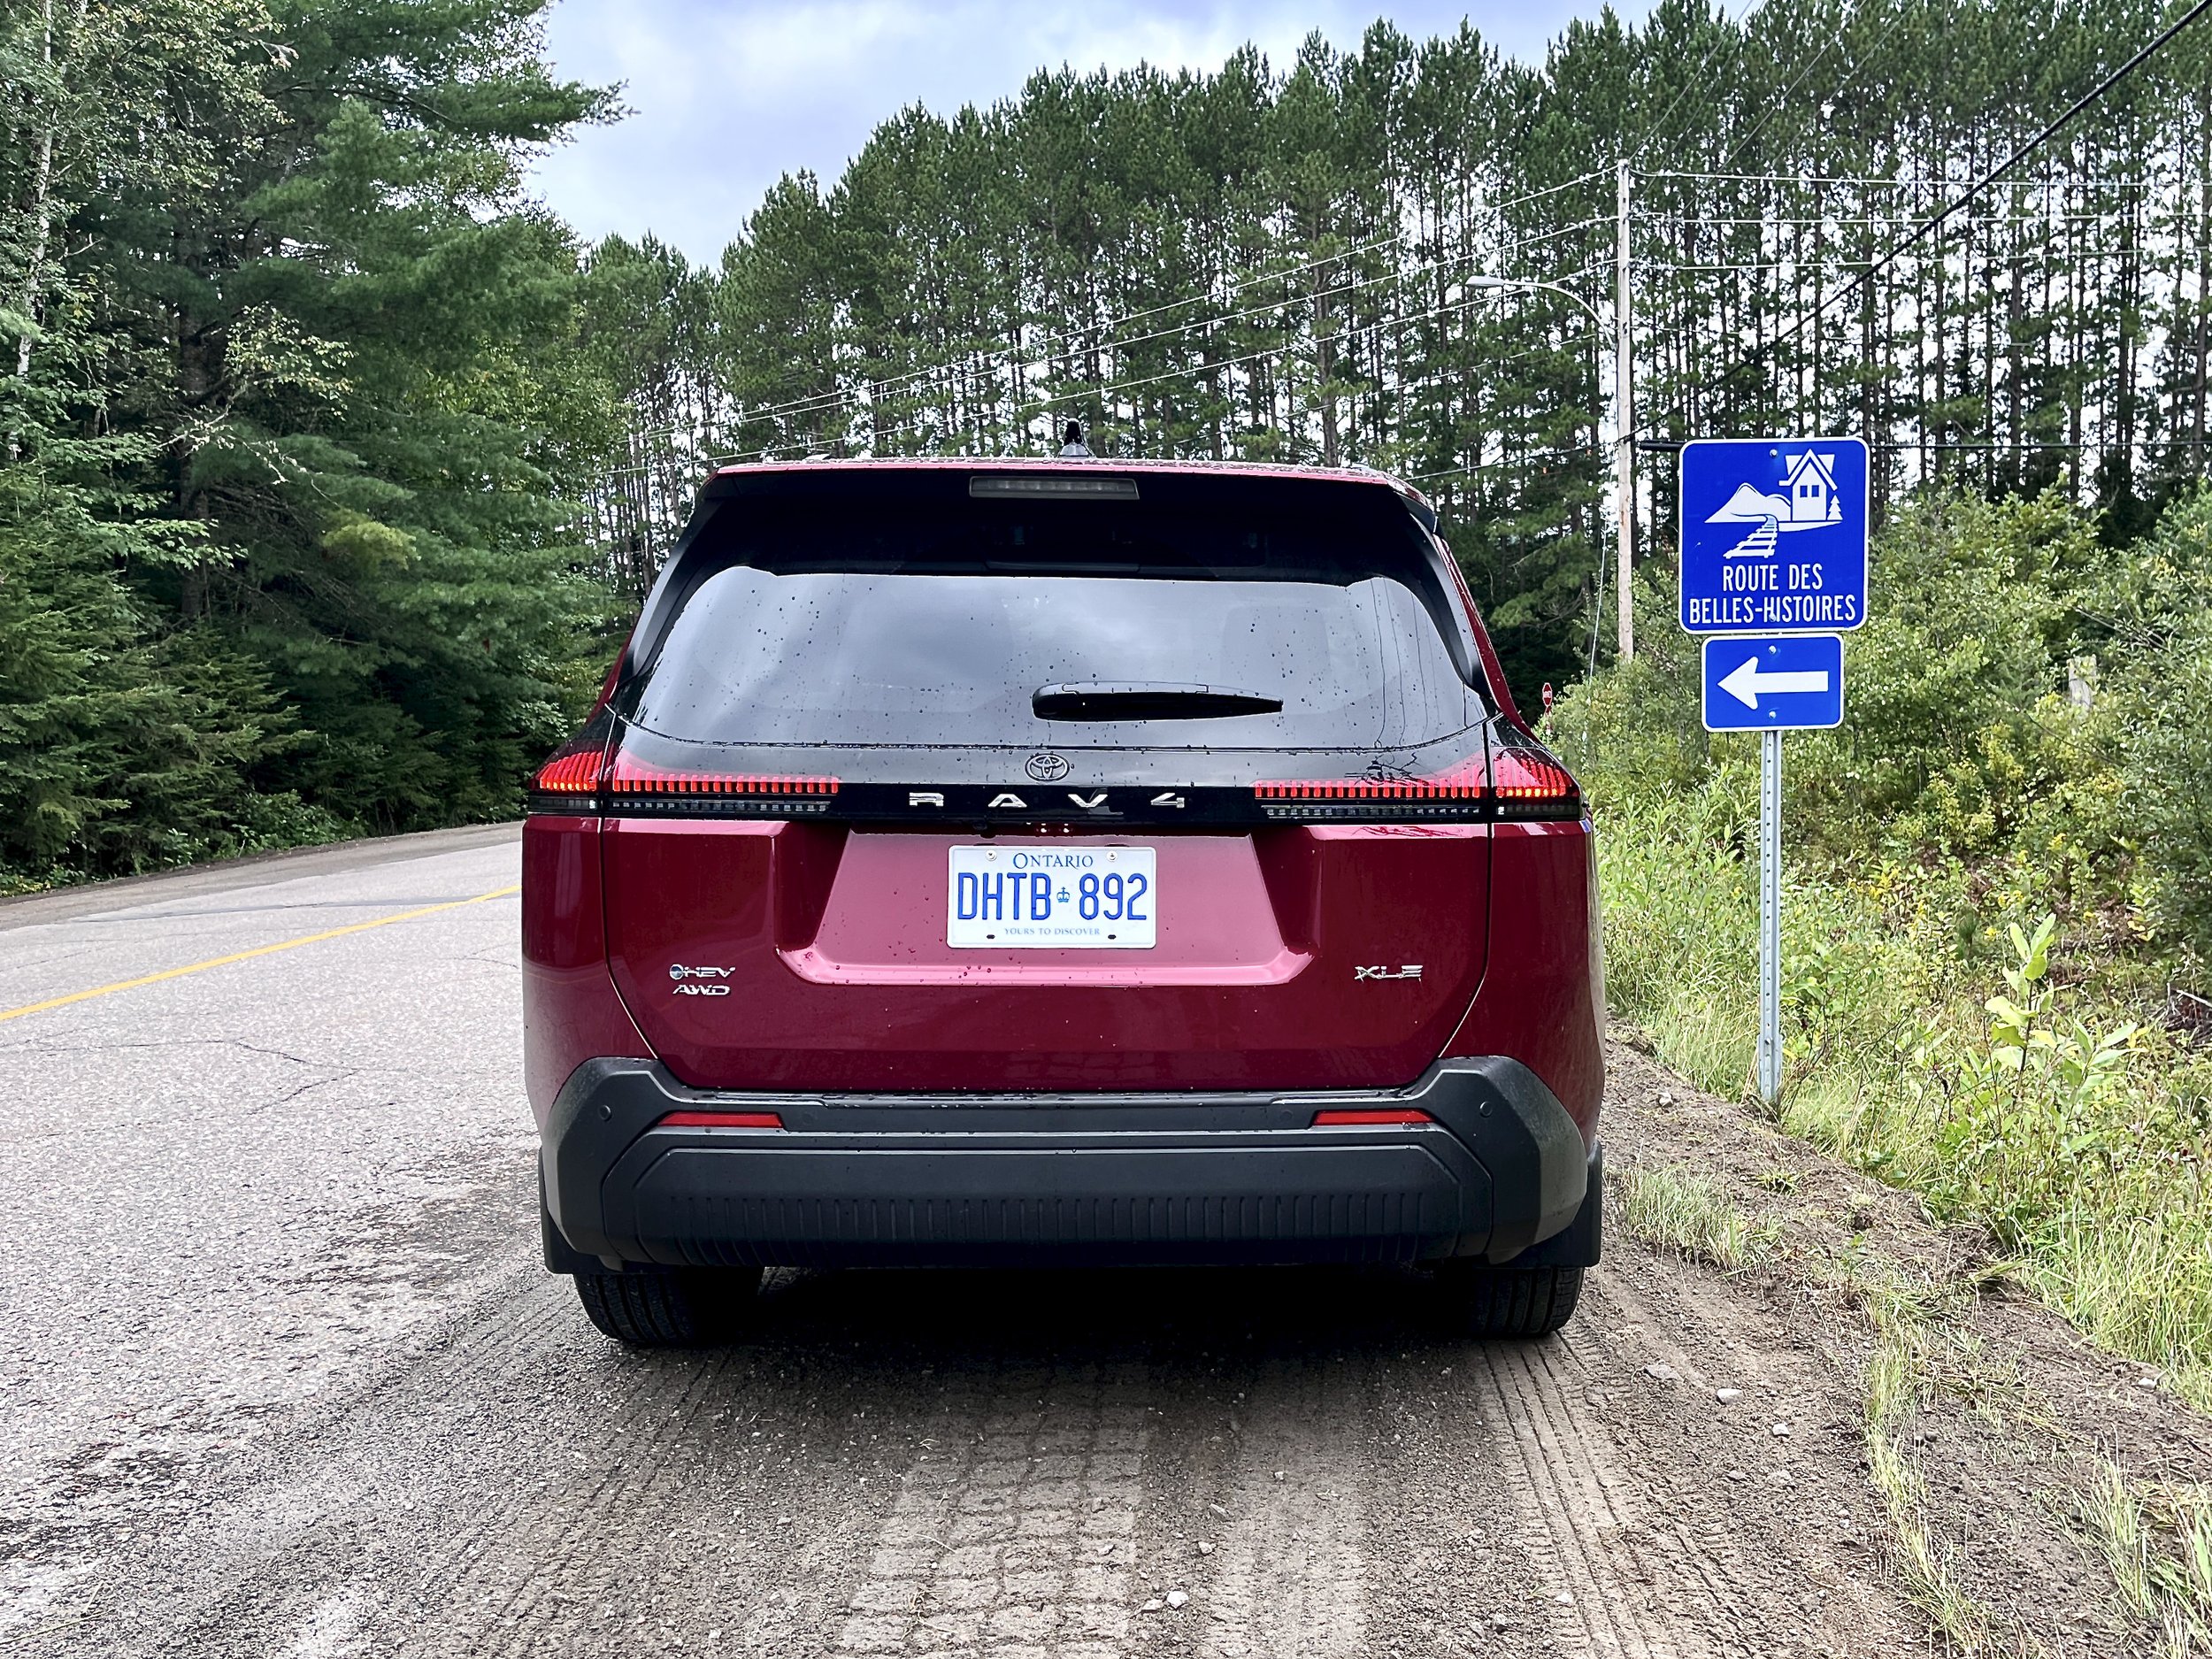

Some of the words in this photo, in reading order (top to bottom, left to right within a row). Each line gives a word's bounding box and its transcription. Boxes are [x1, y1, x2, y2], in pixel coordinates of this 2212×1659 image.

[1723, 565, 1779, 591] ROUTE
[1788, 564, 1823, 590] DES
[1689, 595, 1856, 624] BELLES-HISTOIRES
[909, 792, 1185, 808] RAV4
[957, 872, 1051, 920] DHTB
[1079, 872, 1148, 920] 892
[1354, 965, 1423, 979] XLE
[672, 984, 731, 995] AWD
